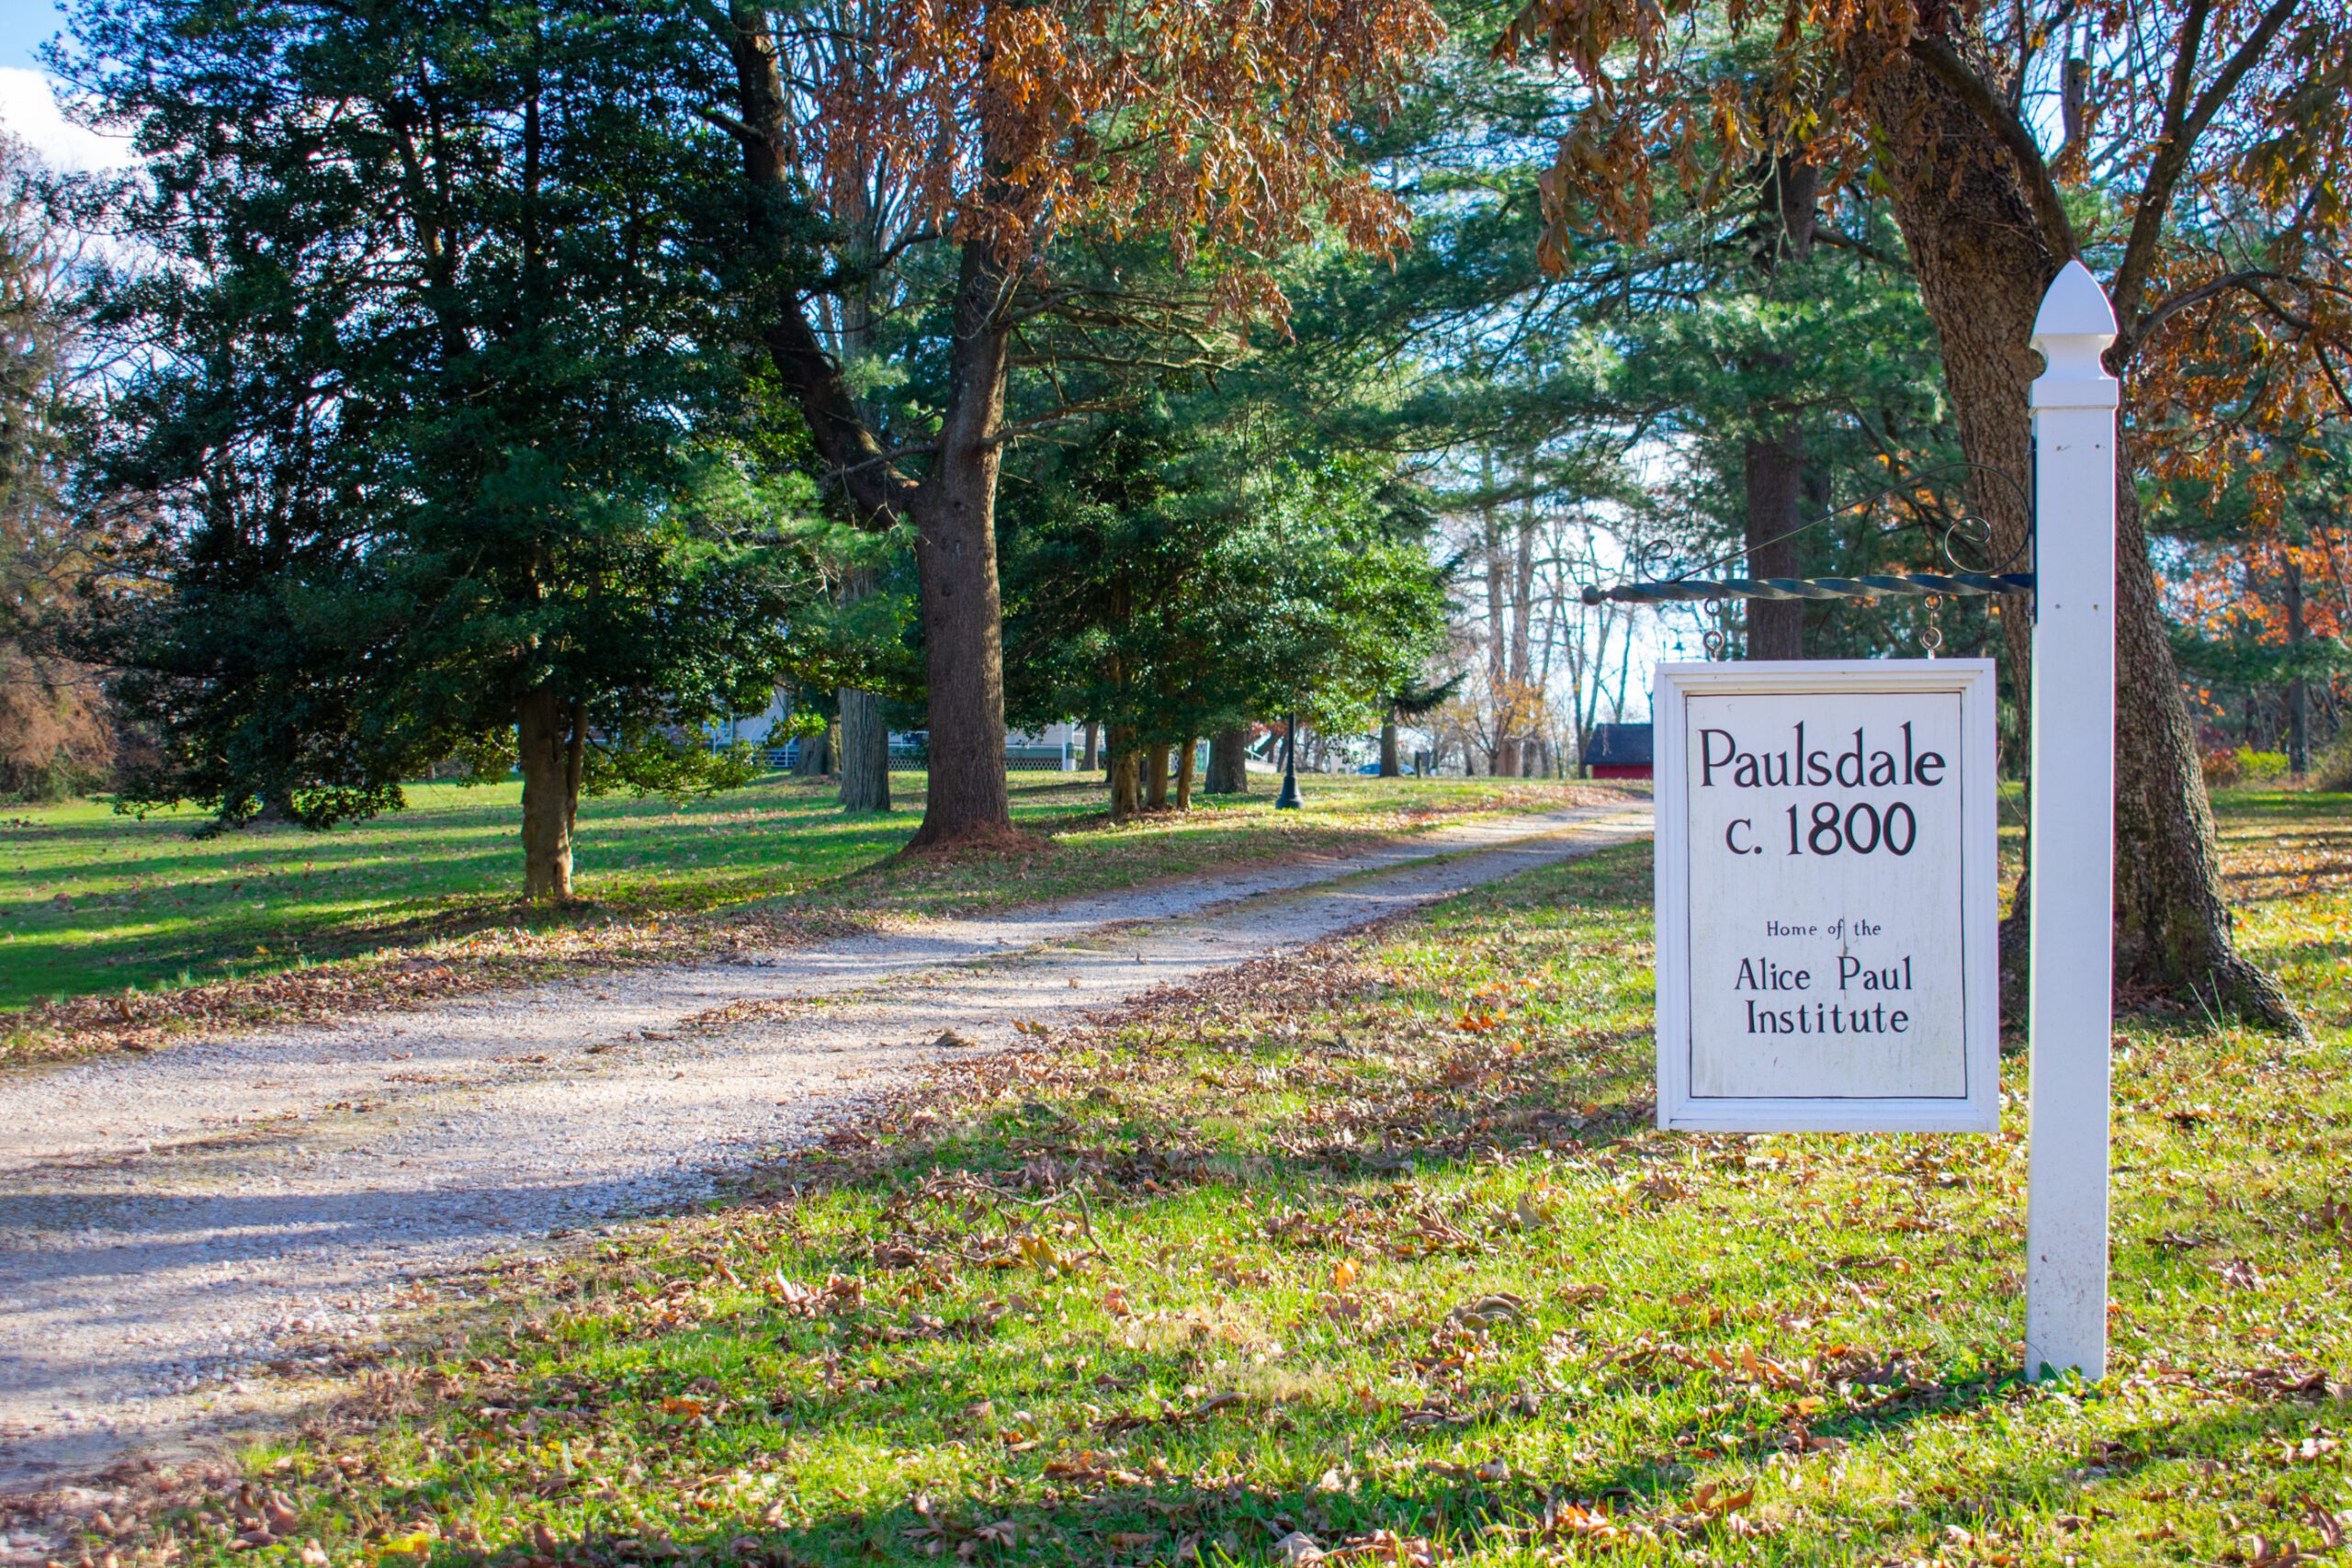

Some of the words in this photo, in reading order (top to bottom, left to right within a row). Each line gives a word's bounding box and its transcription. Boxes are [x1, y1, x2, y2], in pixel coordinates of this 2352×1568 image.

[1699, 720, 1946, 788] Paulsdale
[1725, 818, 1763, 855] c.
[1785, 801, 1917, 857] 1800
[1767, 920, 1817, 937] Home
[1827, 919, 1845, 941] of
[1854, 919, 1882, 937] the
[1734, 956, 1811, 991] Alice
[1837, 955, 1912, 991] Paul
[1745, 999, 1909, 1034] Institute
